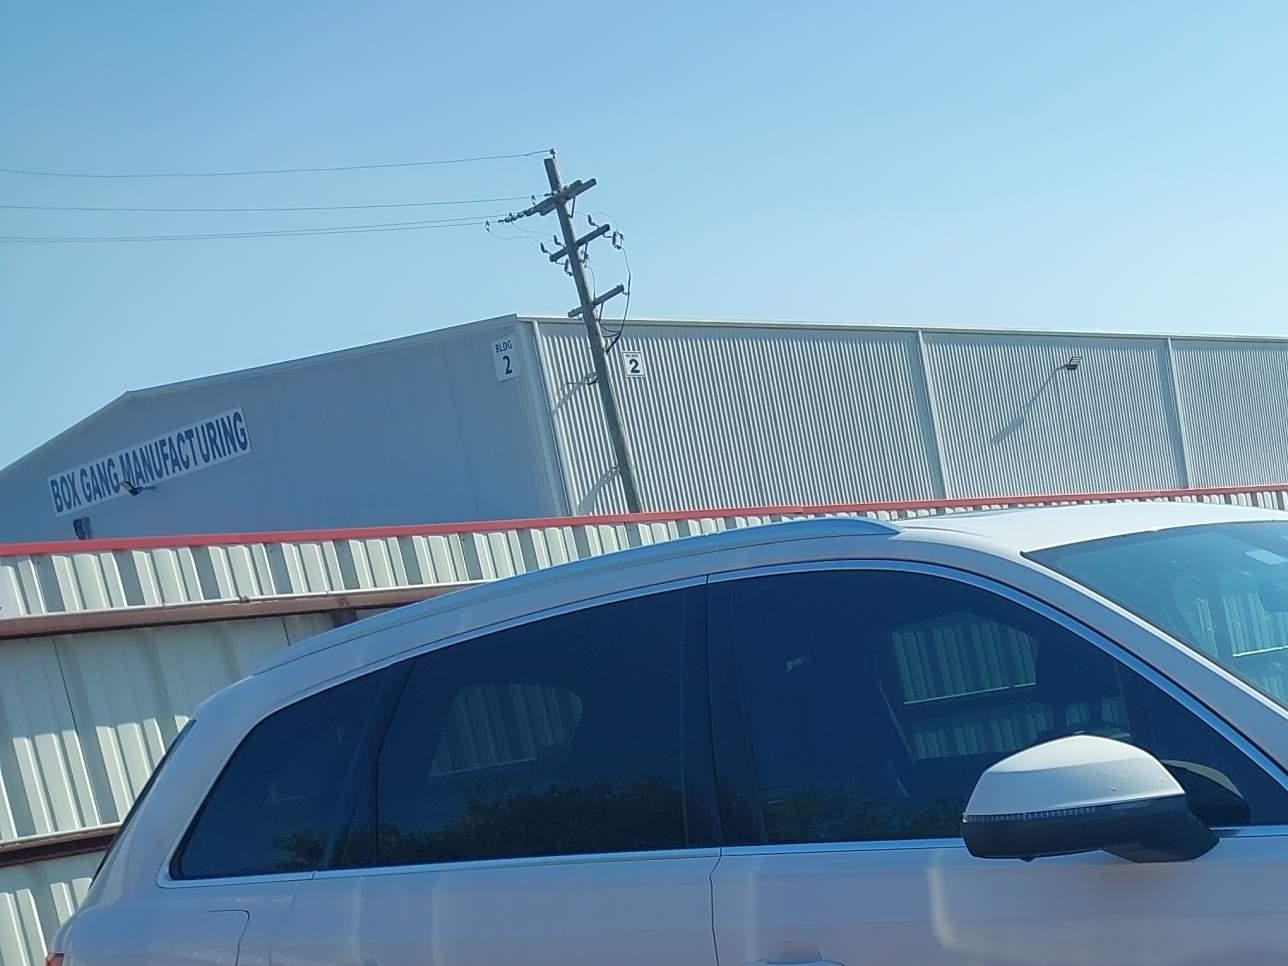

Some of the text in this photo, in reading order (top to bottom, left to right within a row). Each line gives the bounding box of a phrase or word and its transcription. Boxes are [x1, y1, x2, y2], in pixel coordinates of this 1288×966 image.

[495, 339, 513, 353] BLDG
[502, 355, 513, 375] 2
[629, 358, 641, 374] 2
[50, 411, 249, 513] BOX GANG MANUFACTURING
